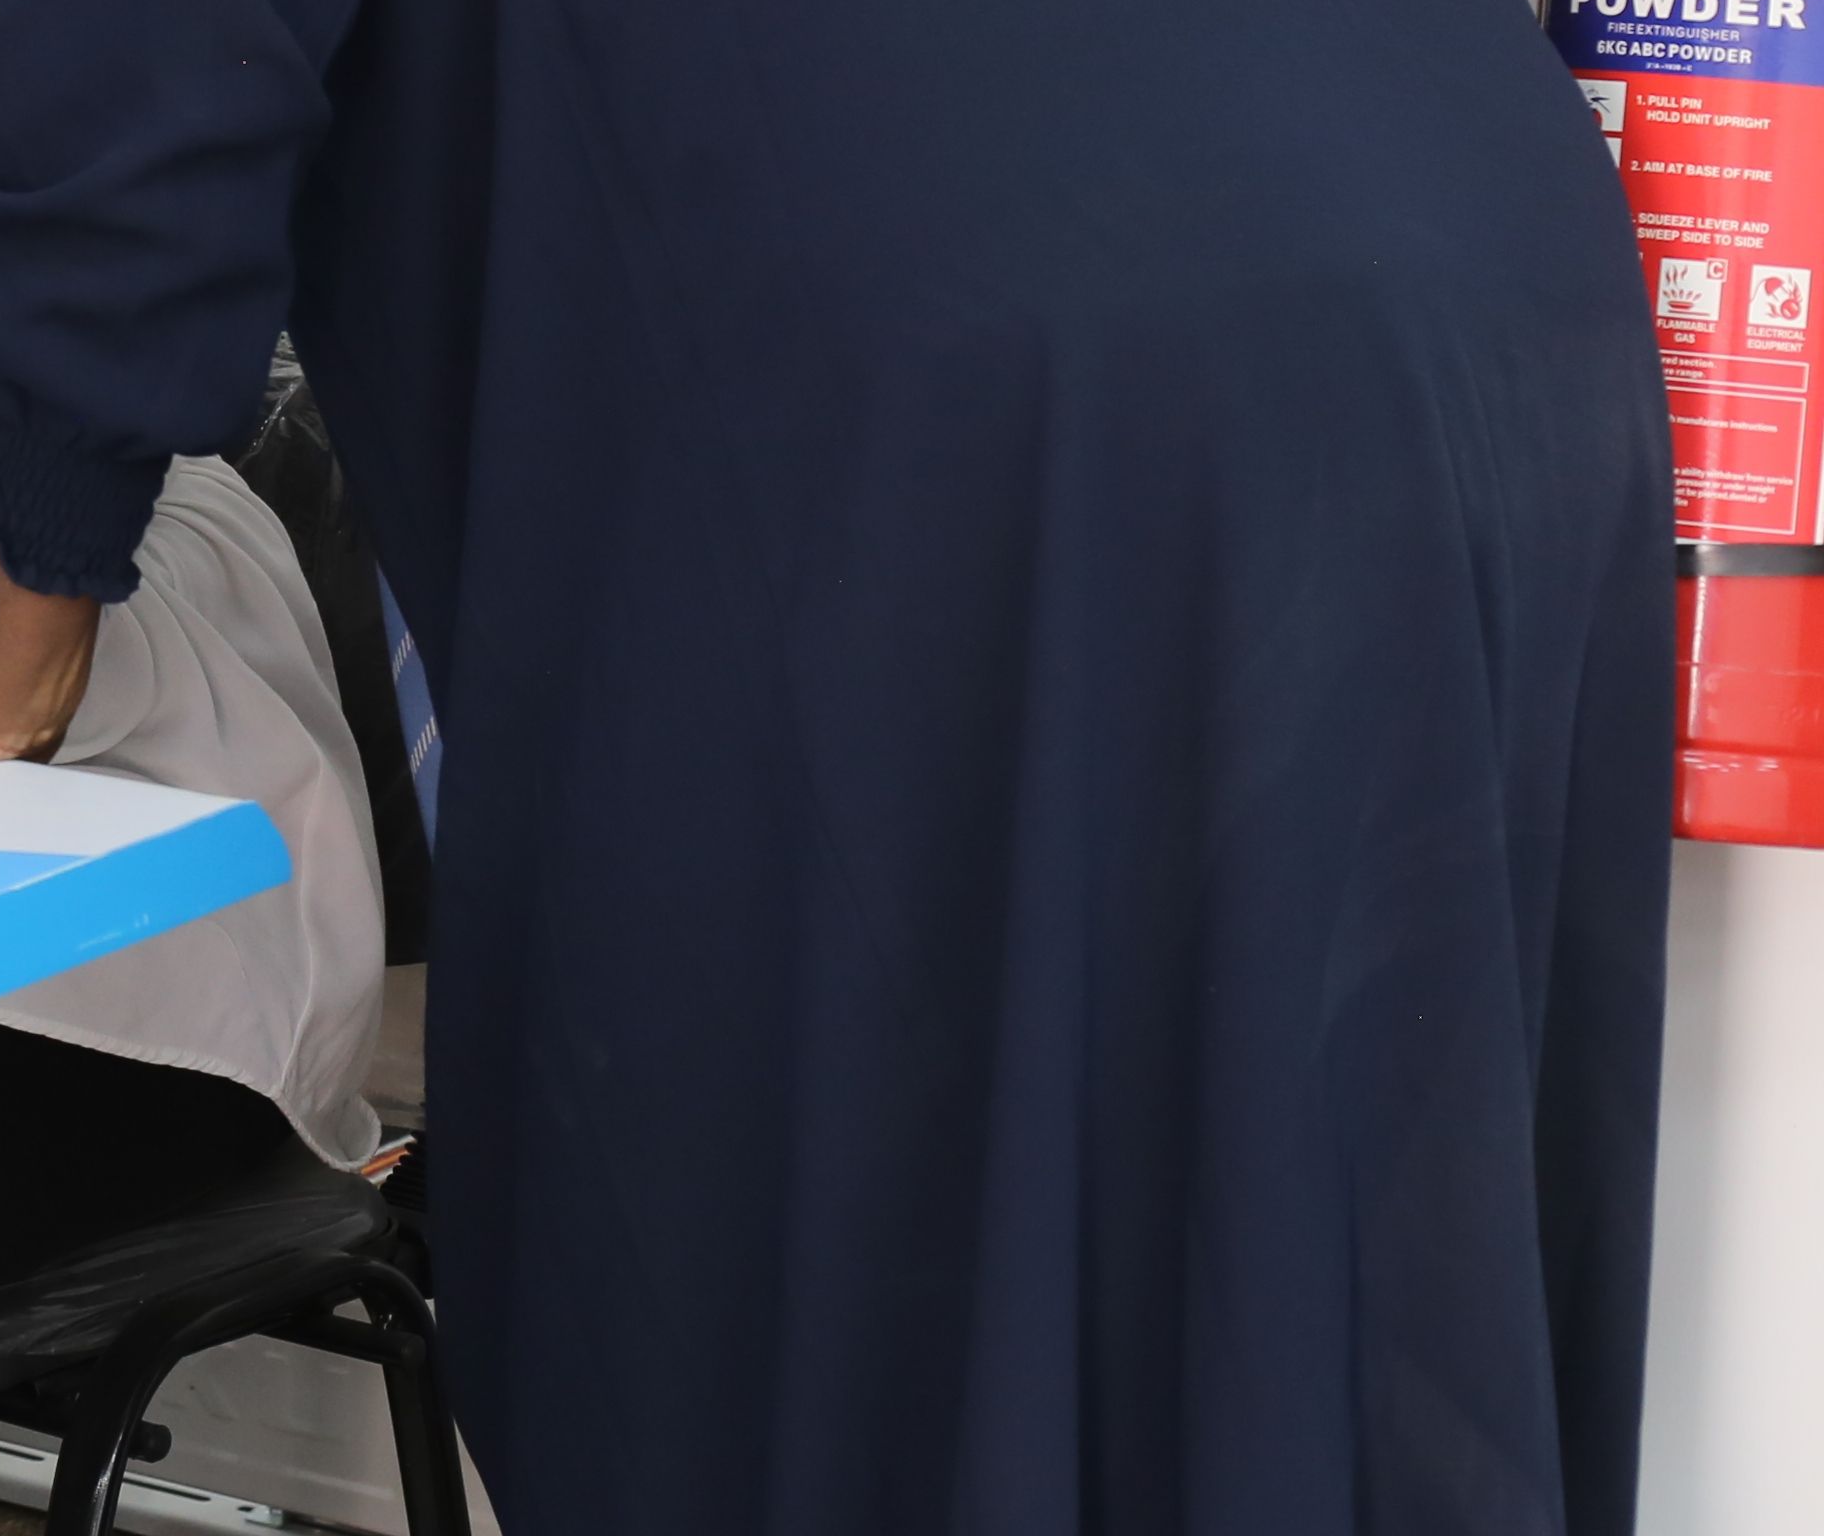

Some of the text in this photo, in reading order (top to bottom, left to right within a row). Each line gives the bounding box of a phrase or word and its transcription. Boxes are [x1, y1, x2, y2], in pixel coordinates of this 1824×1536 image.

[1607, 22, 1740, 42] FIRE EXTINGUISHER
[1596, 40, 1753, 64] 6KG ABC POWDER
[1636, 95, 1703, 110] 1. PULL PIN
[1647, 110, 1771, 129] HOLD UNIT UPRIGHT
[1630, 160, 1773, 182] 2. AIM AT BASE OF FIRE
[1638, 212, 1770, 234] SQUEEZE LEVER AND
[1637, 227, 1764, 249] SWEEP SIDE TO SIDE
[1709, 260, 1724, 278] C
[1657, 319, 1716, 333] FLAMMABLE
[1746, 326, 1806, 341] ELECTRICAL
[1673, 332, 1696, 344] GAS
[1747, 339, 1804, 353] EQUIPMENT
